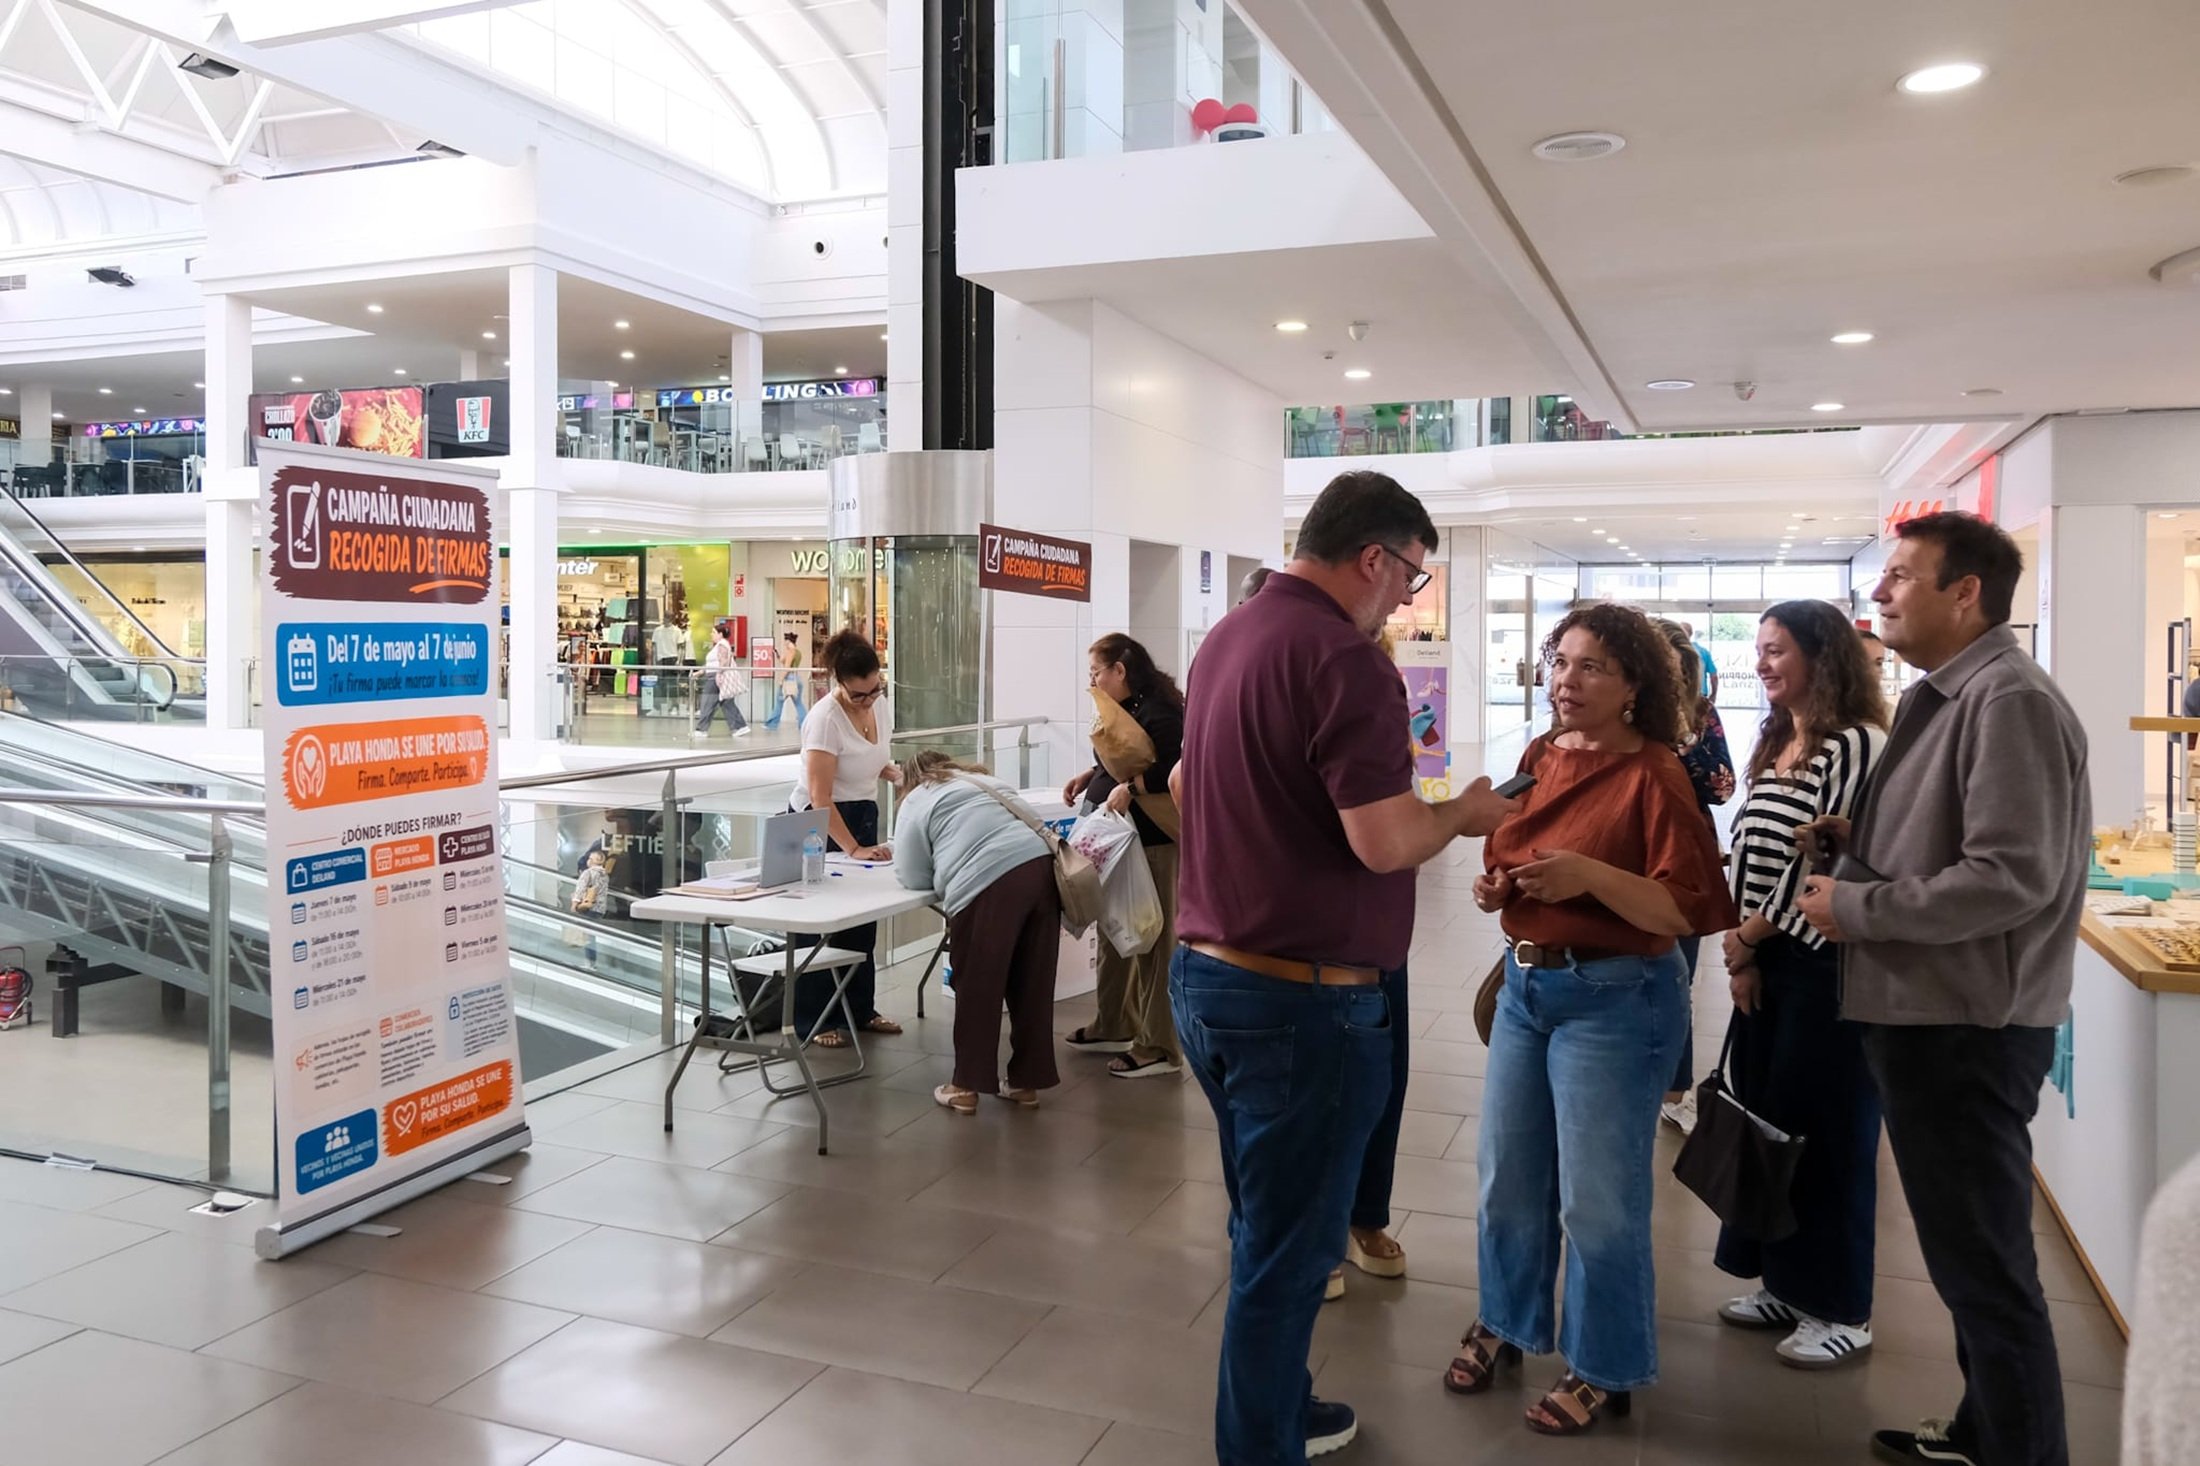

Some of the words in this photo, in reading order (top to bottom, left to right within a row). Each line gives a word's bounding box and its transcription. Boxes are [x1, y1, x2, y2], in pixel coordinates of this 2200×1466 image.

[705, 382, 817, 403] BOLING
[463, 430, 485, 441] KFC
[327, 485, 400, 526] CAMPAÑA
[402, 494, 476, 533] CIUDADANA
[329, 530, 411, 574] RECOGIDA
[416, 536, 435, 574] DE
[436, 538, 488, 577] FIRMAS
[1004, 538, 1039, 559] CAMPAÑA
[1040, 543, 1080, 565] CIUDADANA
[557, 560, 599, 575] nter
[1003, 557, 1043, 580] RECOGIDA
[1045, 564, 1056, 581] DE
[1058, 565, 1086, 586] FIRMAS
[327, 634, 348, 663] Del
[351, 634, 359, 662] 7
[363, 634, 380, 662] de
[383, 640, 415, 667] mayo
[418, 633, 430, 660] al
[432, 633, 441, 660] 7
[330, 741, 363, 766] PLAYA
[365, 737, 400, 764] HONDA
[402, 735, 414, 759] SE
[415, 733, 435, 757] UNE
[437, 731, 456, 755] POR
[358, 770, 386, 790] Firma.
[389, 766, 430, 789] Comparte.
[341, 824, 382, 846] ¿DÓNDE
[385, 818, 420, 836] PUEDES
[422, 812, 462, 831] FIRMAR?
[601, 833, 664, 854] LEFTIE
[420, 1090, 445, 1110] PLAYA
[447, 1080, 475, 1099] HONDA
[476, 1076, 485, 1088] SE
[486, 1068, 503, 1083] UNE
[421, 1108, 439, 1124] POR
[440, 1103, 450, 1116] SU
